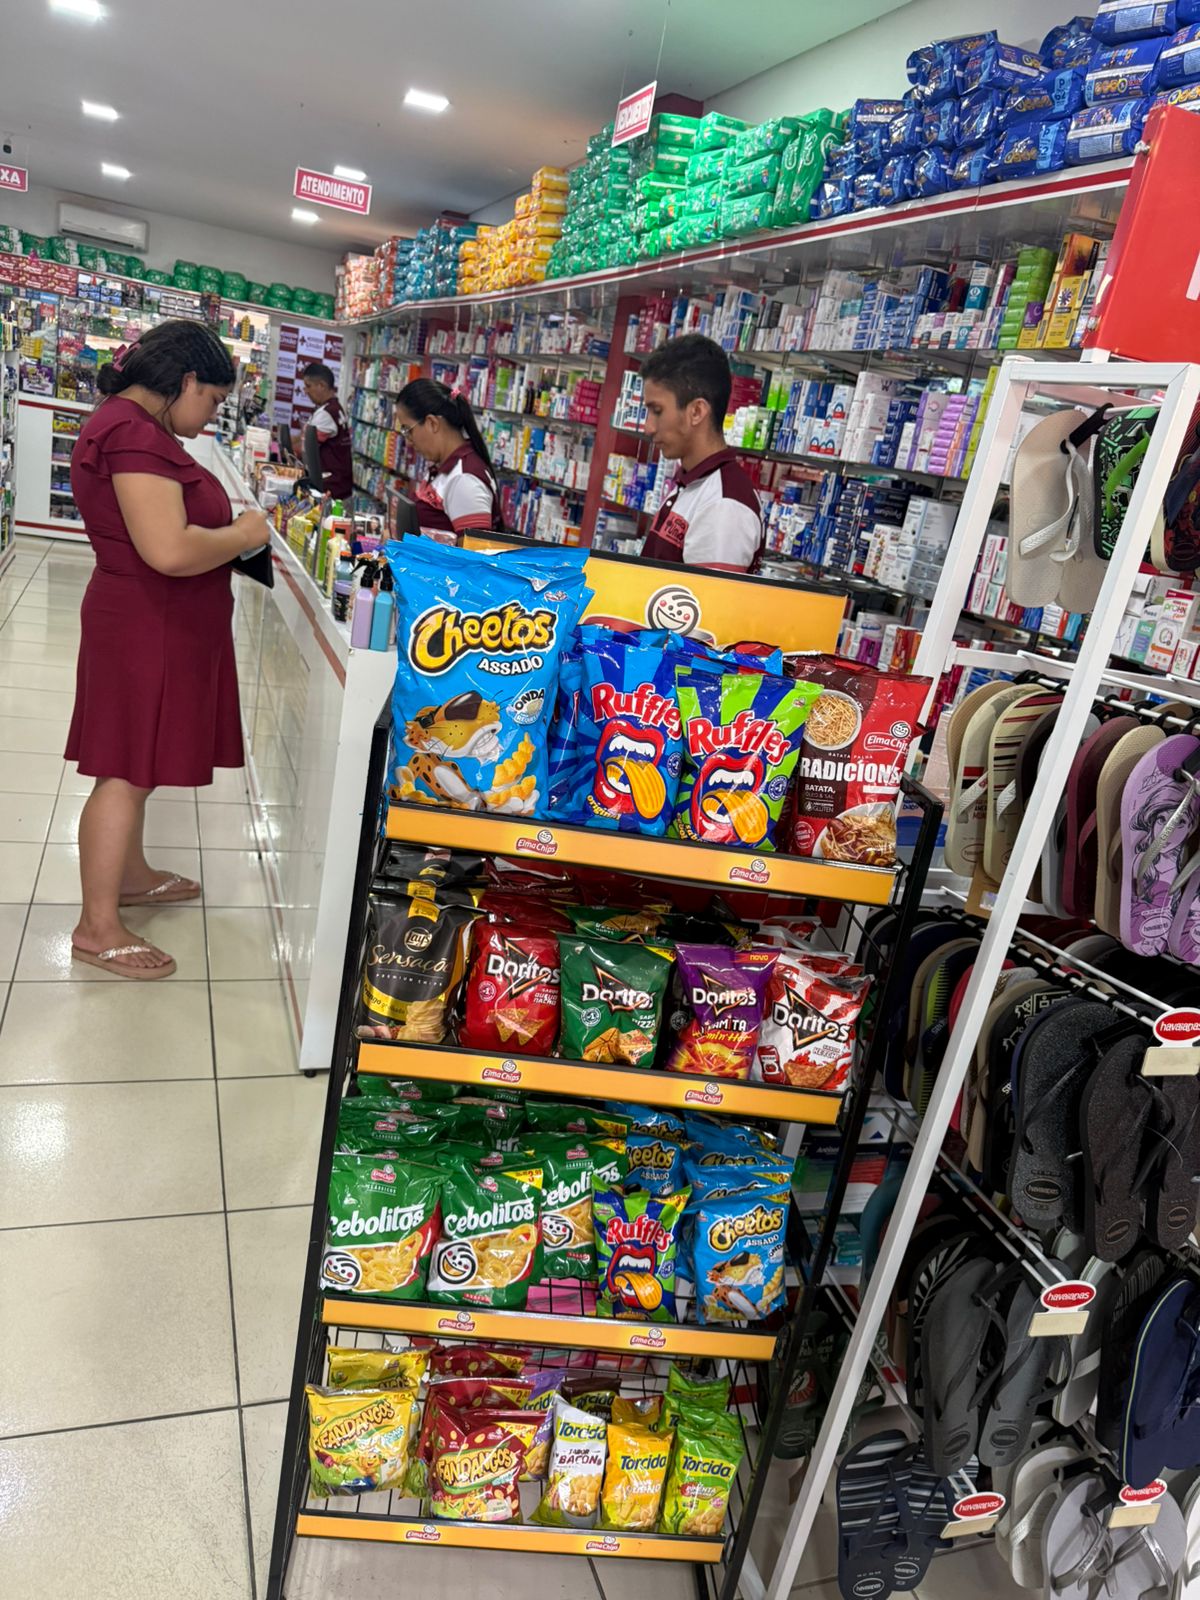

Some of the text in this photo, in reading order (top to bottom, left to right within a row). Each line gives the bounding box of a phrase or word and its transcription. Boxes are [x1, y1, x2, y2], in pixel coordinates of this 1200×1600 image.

[300, 175, 365, 205] ATENDIMENTO
[411, 602, 558, 674] Cheetos
[478, 655, 544, 674] ASSADO
[514, 688, 545, 711] ONDA
[688, 711, 791, 765] Ruffles
[867, 735, 890, 745] Elma
[587, 794, 622, 820] original
[517, 839, 556, 854] Elma Chips
[731, 868, 769, 883] Elma Chips
[367, 944, 449, 973] Sensaçõ
[750, 953, 769, 961] novo
[487, 953, 561, 985] Doritos
[582, 983, 655, 1009] Doritos
[692, 987, 757, 1007] Doritos
[773, 1003, 851, 1043] Doritos
[483, 1069, 521, 1083] Elma Chips
[686, 1092, 722, 1105] Elma Chips
[444, 1197, 535, 1235] Cebolitos
[606, 1214, 674, 1250] Ruffles
[710, 1204, 784, 1252] Cheetos
[744, 1235, 779, 1249] ASSADO
[1047, 1291, 1090, 1301] havaianas
[440, 1319, 474, 1331] Elma Chips
[631, 1335, 665, 1347] Elma Chips
[319, 1398, 395, 1449] FANDANGOS
[559, 1421, 607, 1440] Torcida
[437, 1448, 513, 1486] FANDANGOS
[558, 1454, 598, 1465] BACON
[621, 1453, 667, 1471] Torcida
[682, 1456, 731, 1478] Torcida
[958, 1499, 999, 1512] havaianas
